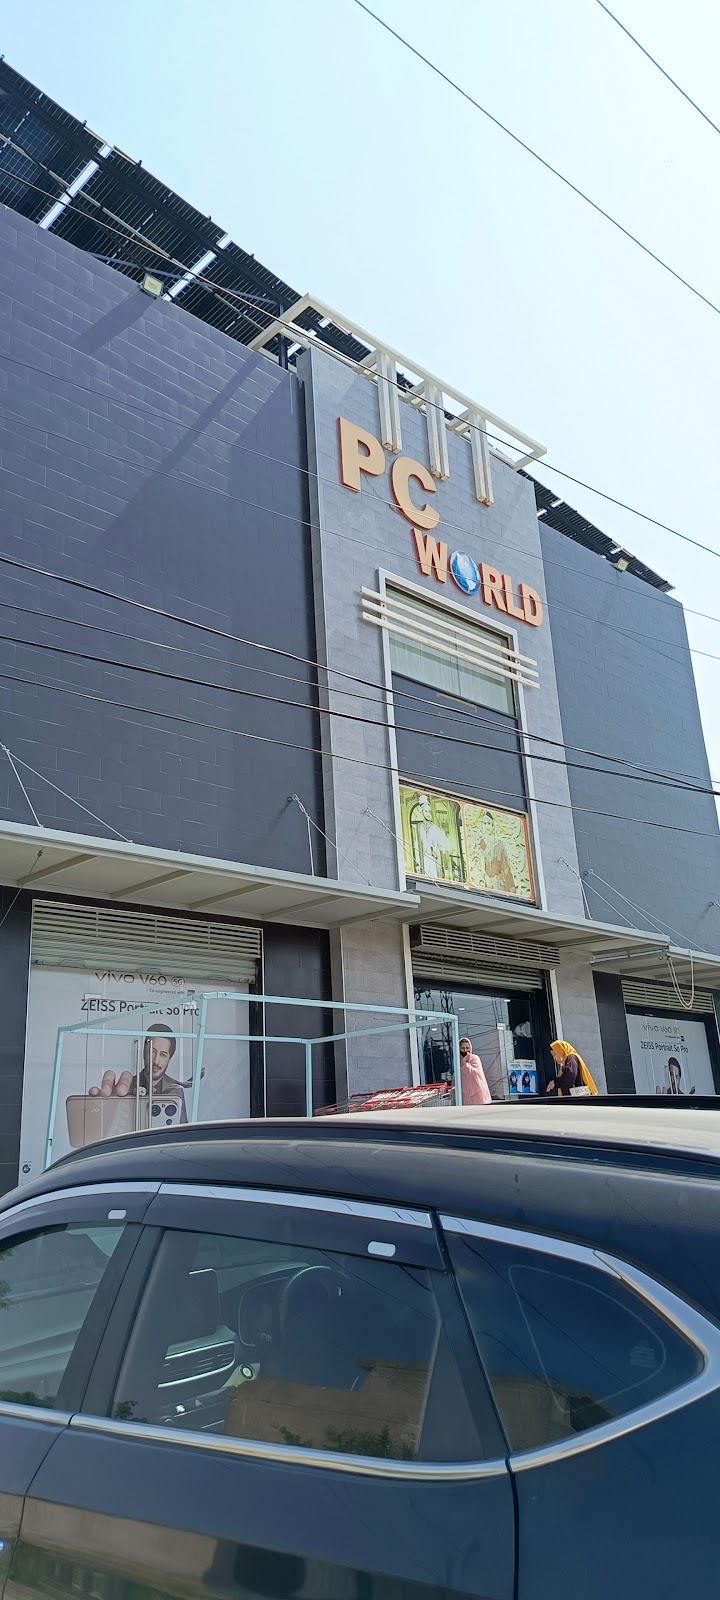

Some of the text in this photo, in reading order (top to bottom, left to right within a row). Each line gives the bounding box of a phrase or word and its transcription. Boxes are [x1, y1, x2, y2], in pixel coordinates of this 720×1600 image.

[338, 417, 440, 530] PC
[412, 527, 543, 628] WORLD
[95, 970, 183, 986] vivo V60 5G
[81, 999, 116, 1012] ZEISS
[641, 1041, 654, 1050] ZEISS
